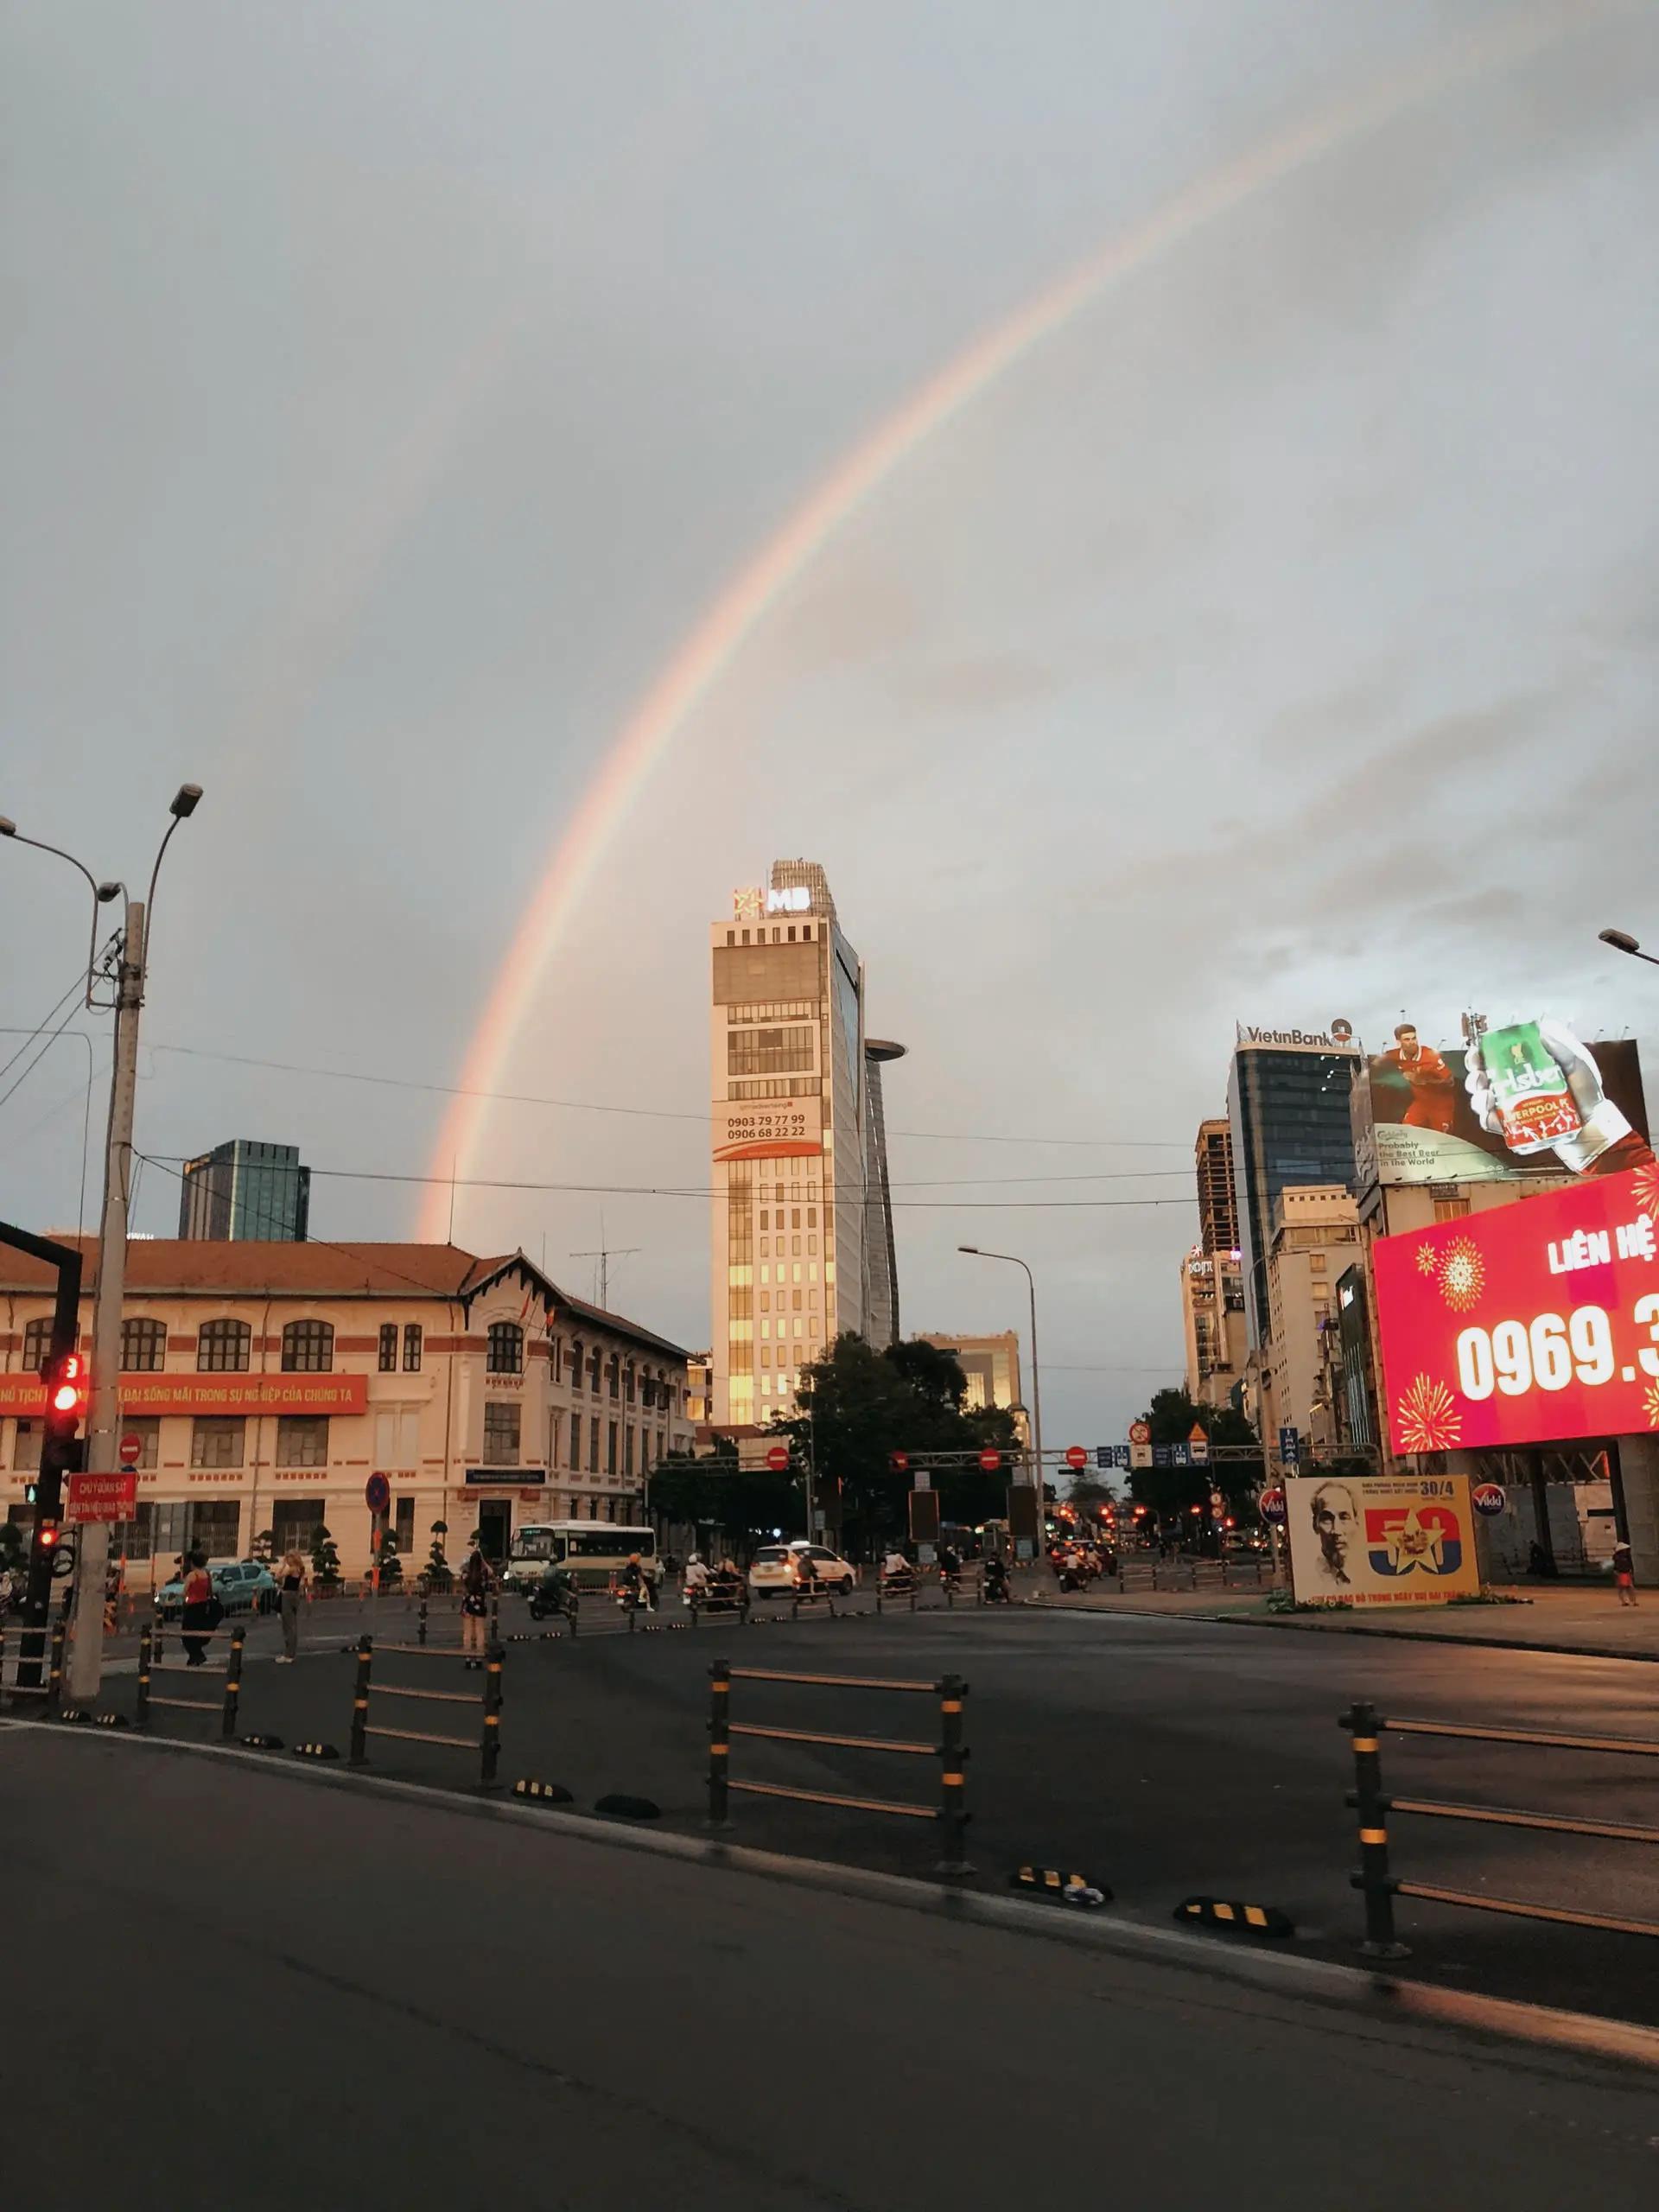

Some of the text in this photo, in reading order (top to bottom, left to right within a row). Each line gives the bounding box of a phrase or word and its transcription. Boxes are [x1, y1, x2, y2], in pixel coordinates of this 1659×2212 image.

[767, 887, 810, 912] MB
[1247, 1027, 1333, 1047] VietinBank
[728, 1115, 805, 1127] 0903 79 77 99
[728, 1127, 805, 1139] 0906 68 22 22
[1548, 1213, 1656, 1274] LIÊN HỆ
[195, 1388, 226, 1402] TRONG
[340, 1389, 353, 1402] TA
[1420, 1481, 1454, 1495] 30/4
